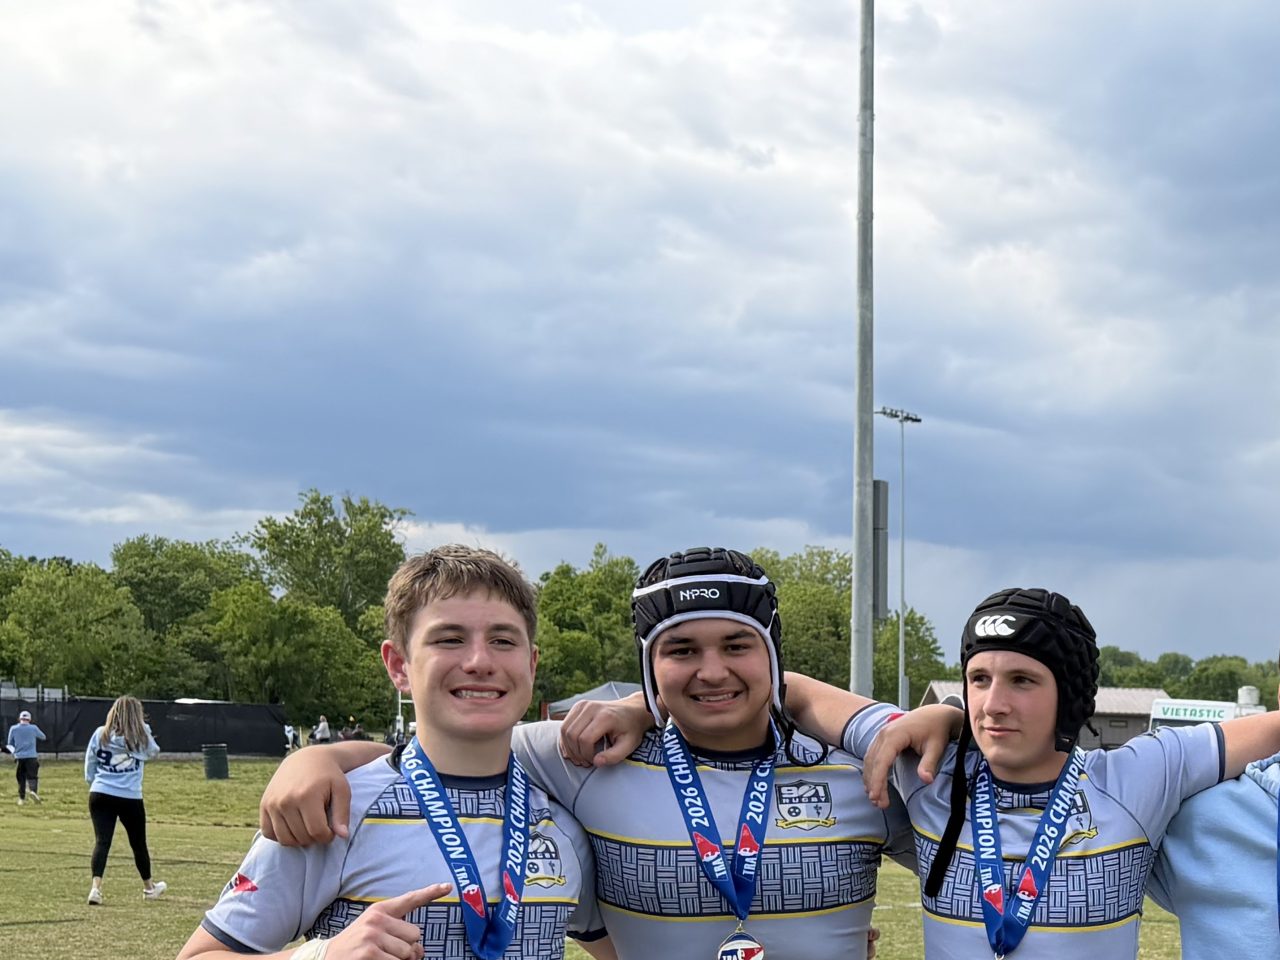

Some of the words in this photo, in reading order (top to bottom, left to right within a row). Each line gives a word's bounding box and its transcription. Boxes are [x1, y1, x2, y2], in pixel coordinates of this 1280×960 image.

[1162, 706, 1225, 719] VIETASTIC
[780, 785, 826, 798] 901
[782, 796, 826, 804] RUGBY
[680, 787, 710, 828] 2026
[746, 781, 768, 825] 2026
[410, 769, 468, 860] CHAMPION
[975, 771, 997, 859] CHAMPION
[507, 827, 525, 876] 2026
[1031, 823, 1059, 872] 2026
[454, 866, 469, 887] TRA
[711, 856, 728, 879] TRA
[742, 857, 757, 876] TRA
[980, 866, 994, 888] TRA
[1016, 900, 1034, 920] TRA
